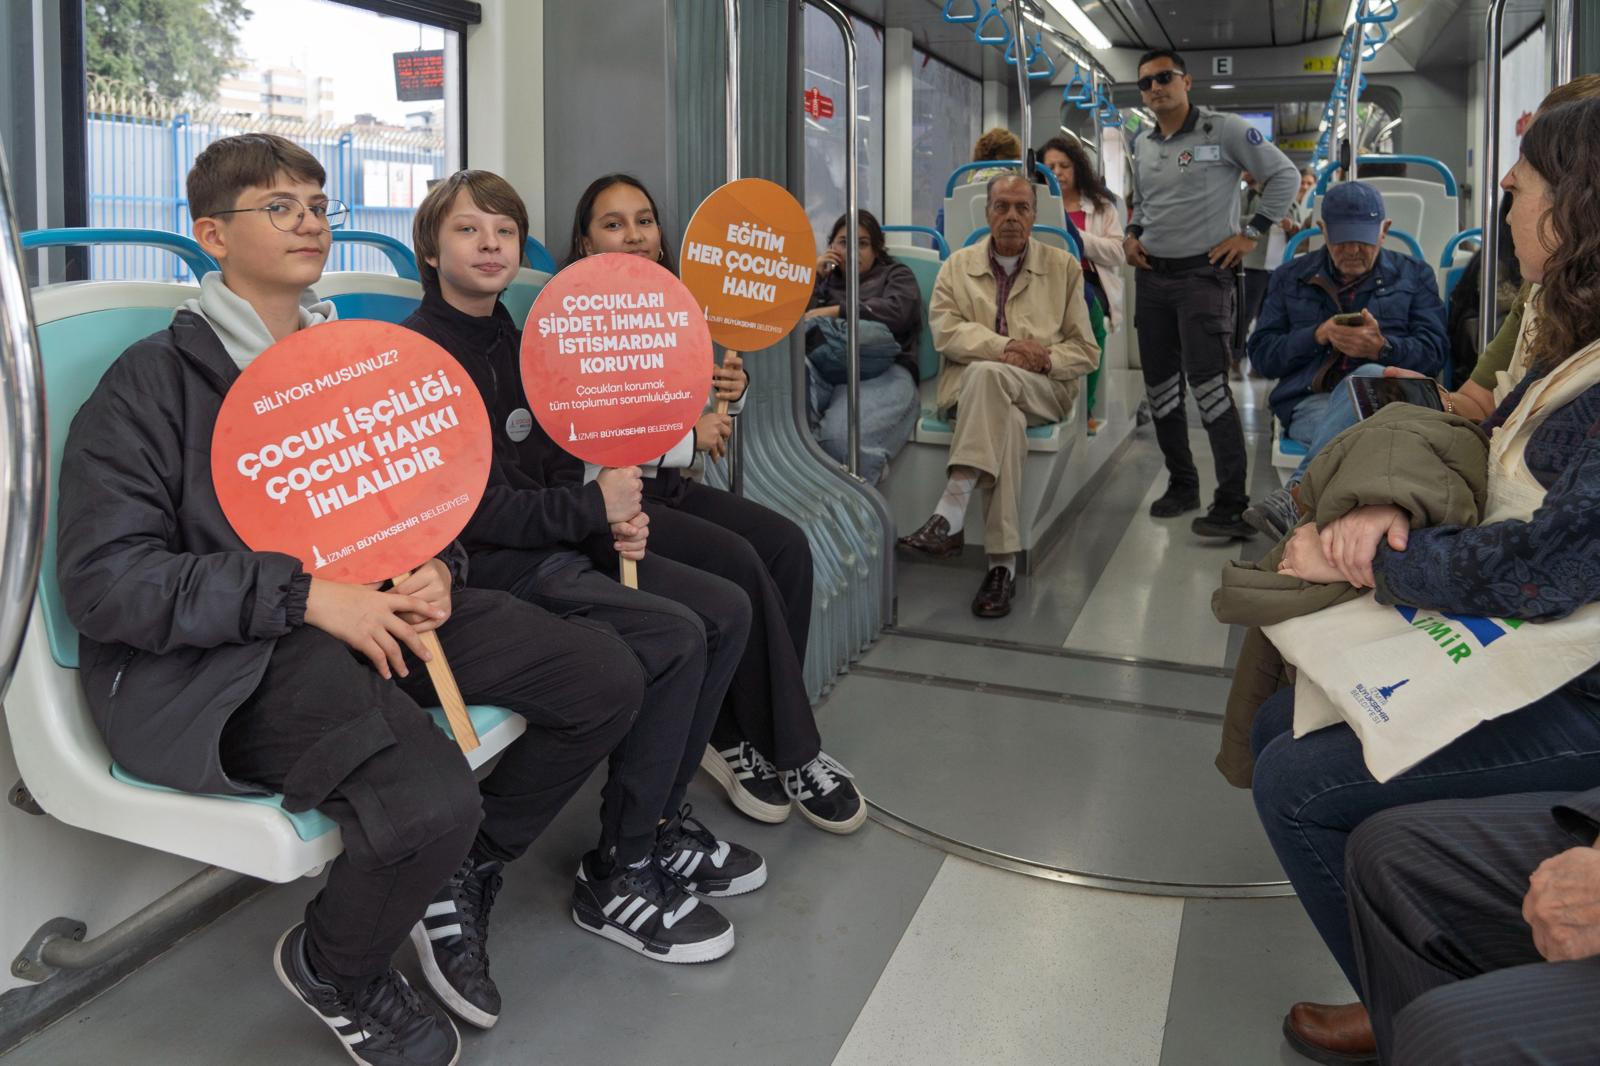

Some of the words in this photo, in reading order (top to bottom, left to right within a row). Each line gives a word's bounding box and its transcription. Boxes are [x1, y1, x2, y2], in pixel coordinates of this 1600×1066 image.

[1217, 58, 1228, 74] E
[726, 221, 786, 254] EĞİTİM
[687, 241, 724, 266] HER
[725, 249, 813, 285] ÇOCUĞUN
[562, 292, 665, 314] ÇOCUKLARI
[722, 275, 777, 303] HAKKI
[538, 313, 608, 338] ŞİDDET,
[611, 310, 664, 331] İHMAL
[667, 312, 689, 327] VE
[558, 330, 677, 355] İSTİSMARDAN
[580, 353, 665, 375] KORUYUN
[253, 382, 315, 415] BİLİYOR
[315, 349, 400, 392] MUSUNUZ?
[576, 382, 623, 397] Çocukları
[624, 379, 665, 392] korumak
[549, 401, 570, 412] tüm
[571, 396, 619, 411] toplumun
[619, 389, 693, 406] sorumluluğudur.
[236, 418, 346, 481] ÇOCUK
[343, 369, 462, 435] İŞÇİLİĞİ,
[265, 441, 373, 504] ÇOCUK
[372, 405, 460, 457] HAKKI
[305, 446, 445, 519] İHLALİDİR
